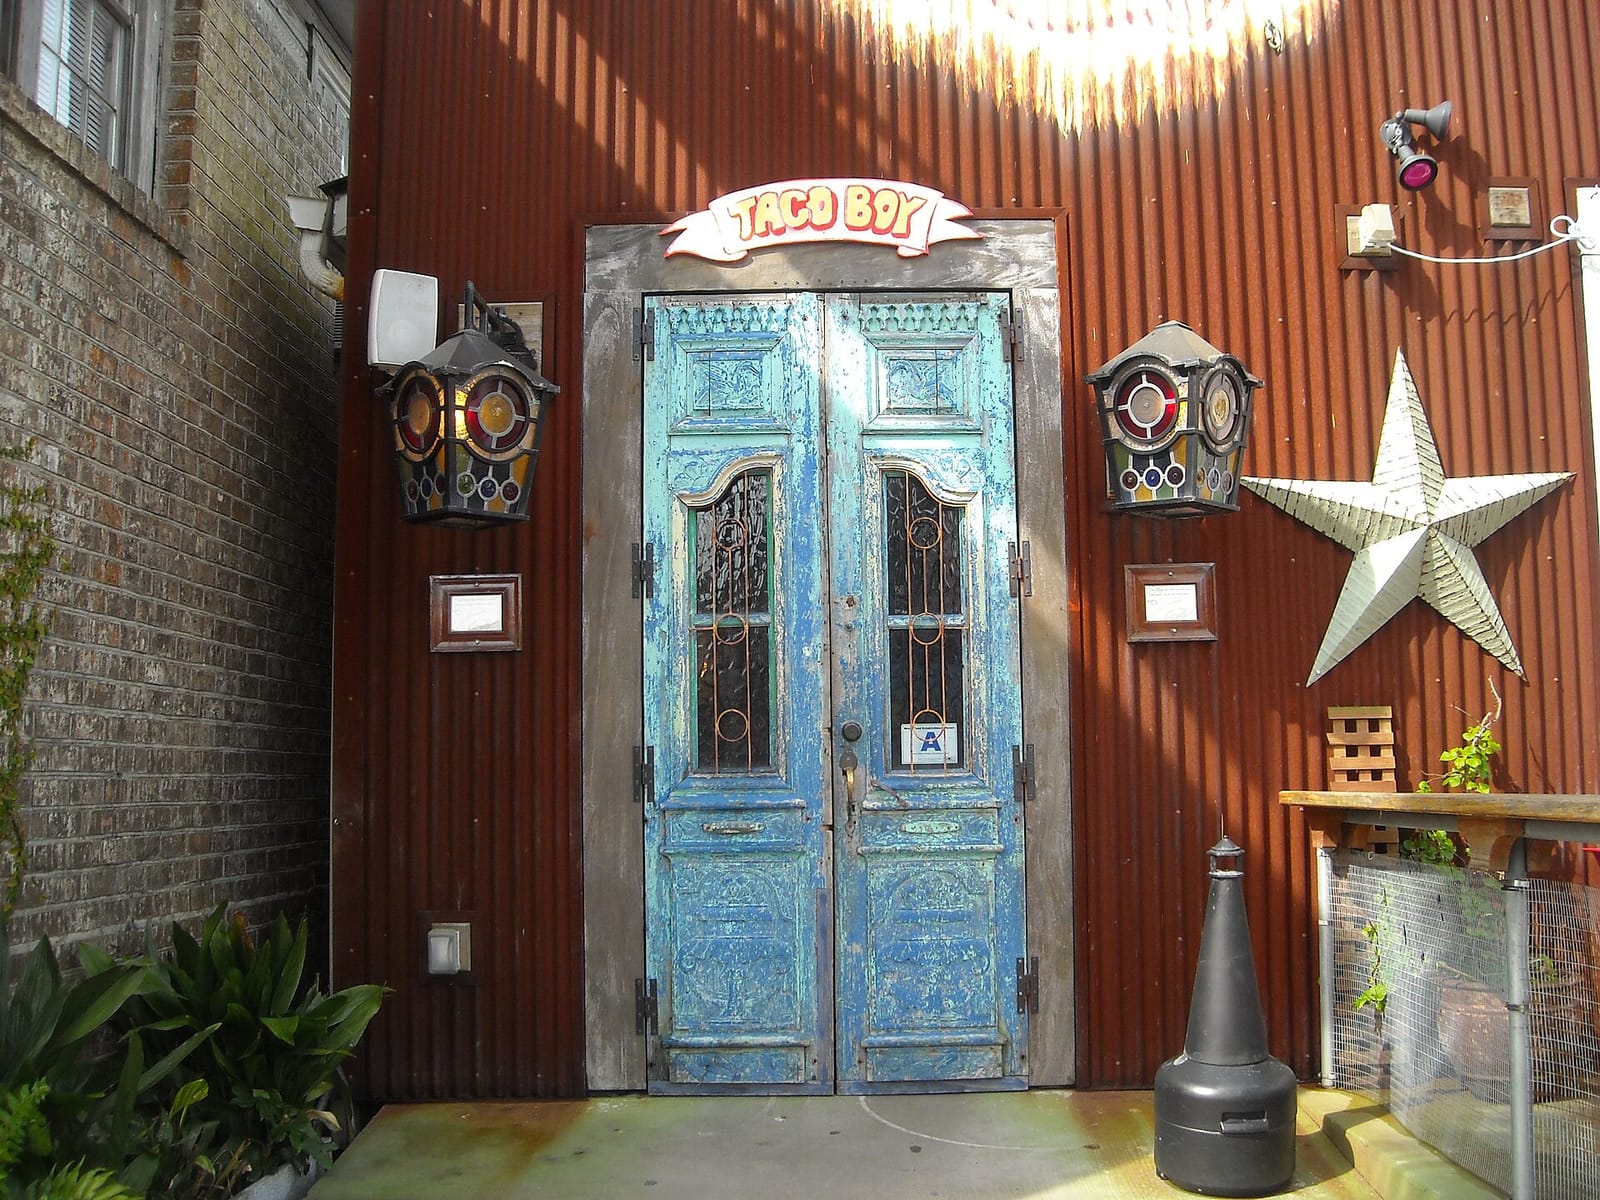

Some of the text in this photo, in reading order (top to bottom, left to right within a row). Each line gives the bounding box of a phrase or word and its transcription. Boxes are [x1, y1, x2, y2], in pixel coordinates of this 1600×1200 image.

[728, 185, 927, 241] TACO BOY
[921, 731, 941, 751] A
